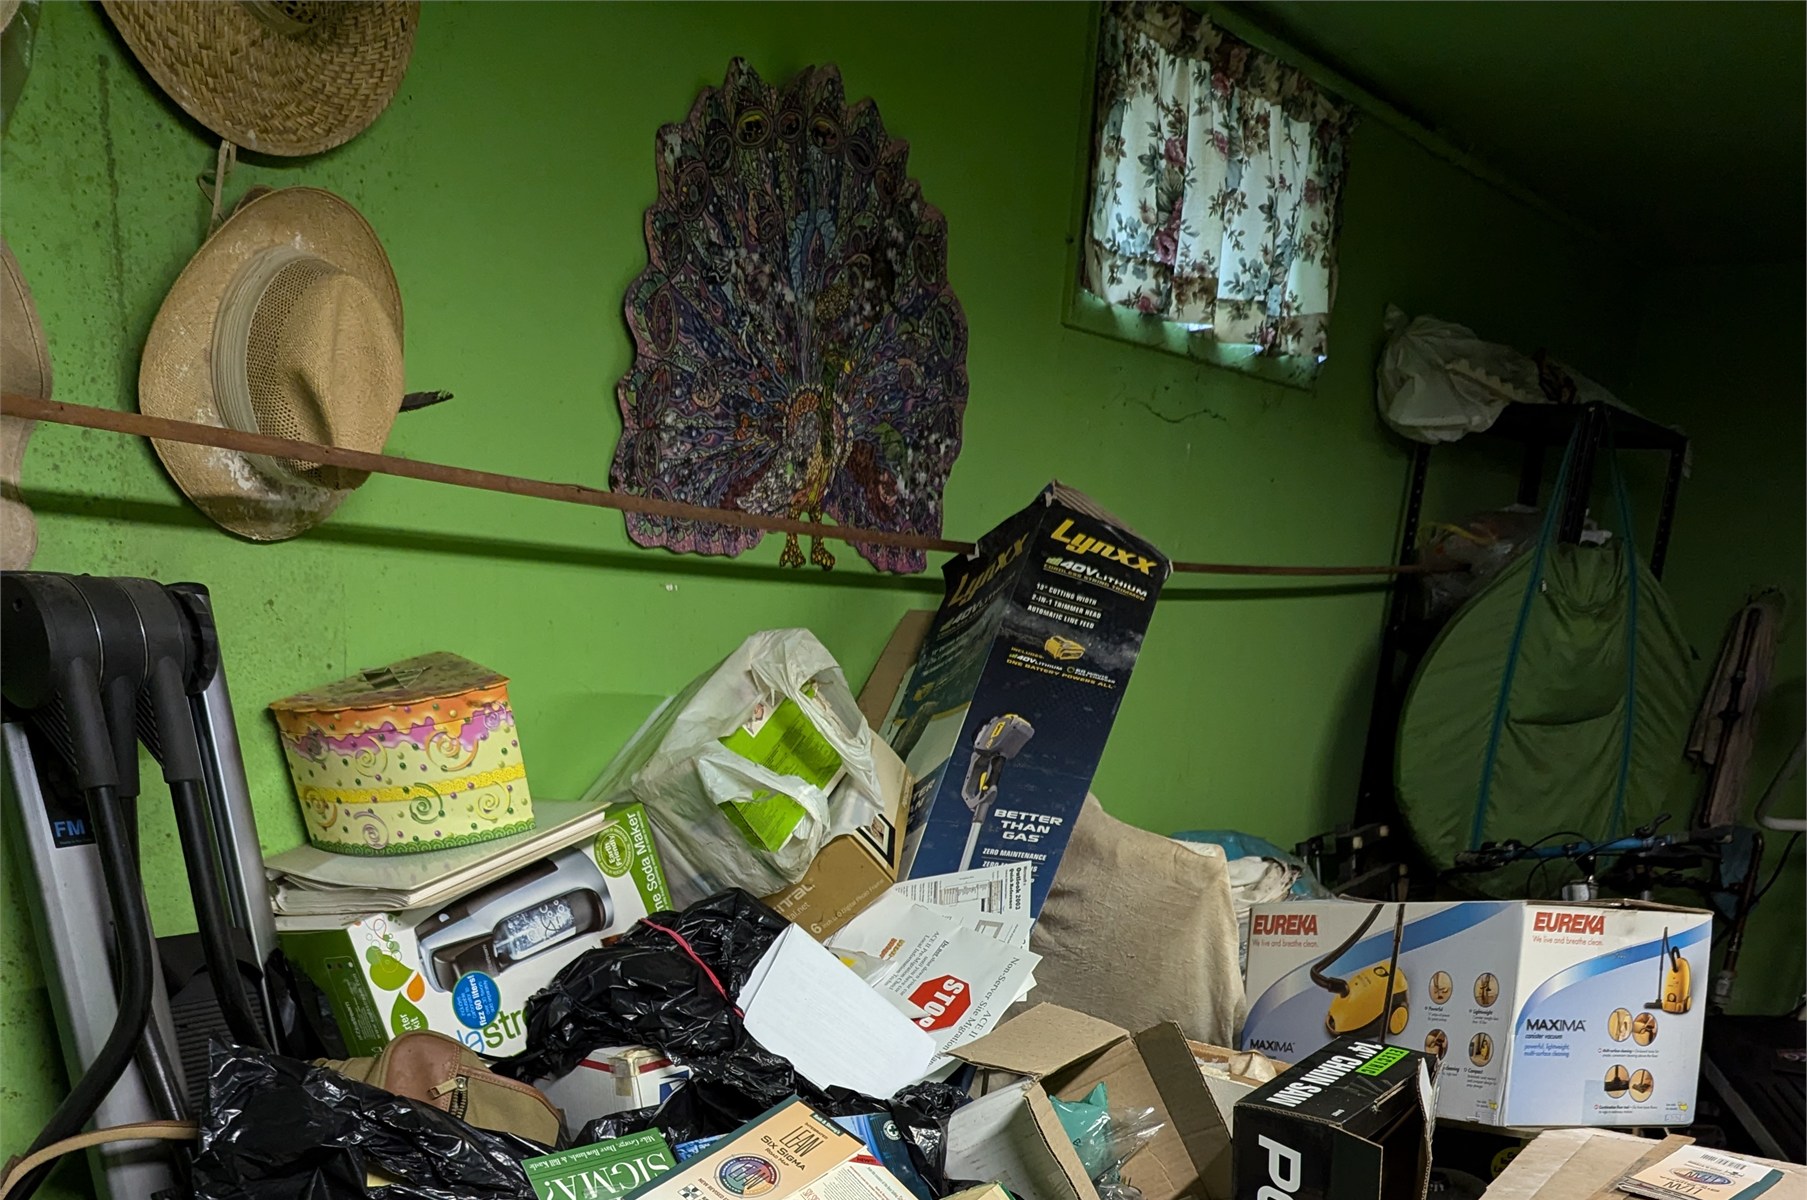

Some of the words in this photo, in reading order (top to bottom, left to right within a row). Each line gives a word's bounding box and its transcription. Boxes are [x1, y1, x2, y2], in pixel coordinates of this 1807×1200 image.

[1050, 518, 1158, 575] Lynxx
[1027, 604, 1062, 621] AUTOMATIC
[1054, 599, 1084, 614] TRIMMER
[1085, 606, 1102, 620] HEAD
[994, 808, 1063, 827] BETTER
[1001, 820, 1051, 834] THAN
[54, 819, 86, 838] FM
[626, 812, 648, 857] Maker
[1002, 831, 1042, 844] GAS
[982, 848, 999, 857] ZERO
[1000, 849, 1047, 862] MAINTENANCE
[641, 856, 658, 892] Soda
[810, 923, 822, 934] 6
[1253, 914, 1318, 936] EUREKA
[1533, 911, 1605, 935] EUREKA
[985, 956, 1020, 1002] Non-Server
[918, 979, 965, 1028] STOP
[972, 1000, 988, 1016] Site
[975, 1010, 992, 1030] ACE
[1526, 1018, 1584, 1032] MAXIMA
[943, 1016, 977, 1051] Migration
[1250, 1038, 1293, 1053] MAXIMA
[1300, 1055, 1363, 1087] CHAIN
[1361, 1048, 1405, 1075] ELECTRIC
[1266, 1082, 1322, 1107] SAW
[779, 1126, 825, 1158] LEAN
